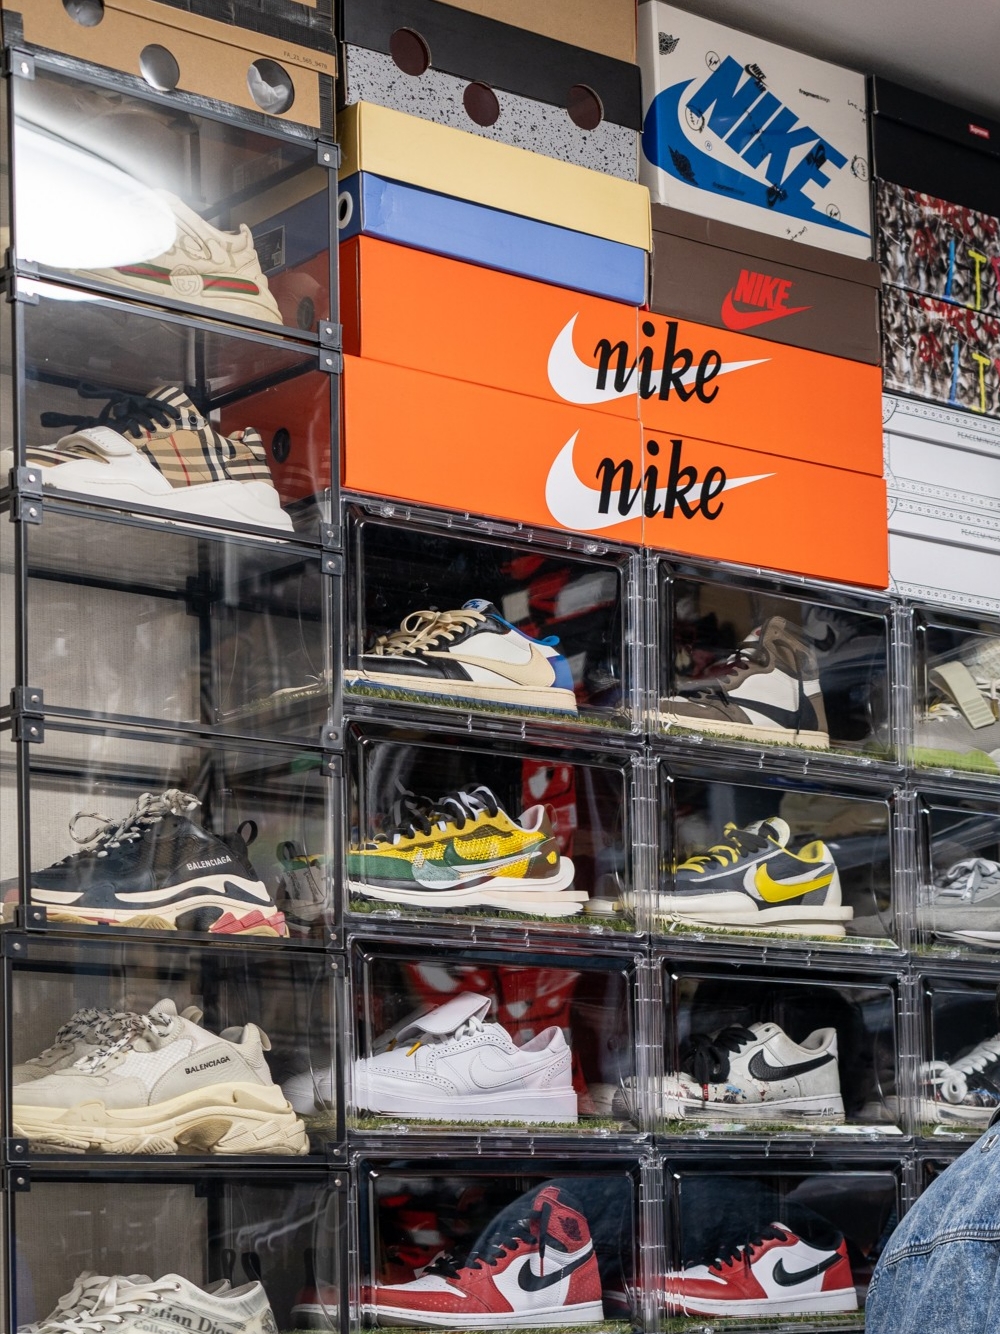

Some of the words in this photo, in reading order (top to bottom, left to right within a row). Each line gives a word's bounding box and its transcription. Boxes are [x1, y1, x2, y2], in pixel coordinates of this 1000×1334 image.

[686, 55, 848, 208] NIKE
[733, 268, 793, 310] NIKE
[593, 321, 722, 404] nike
[595, 439, 727, 520] nike
[185, 854, 233, 871] BALENCIAGA
[184, 1054, 232, 1075] BALENCIAGA
